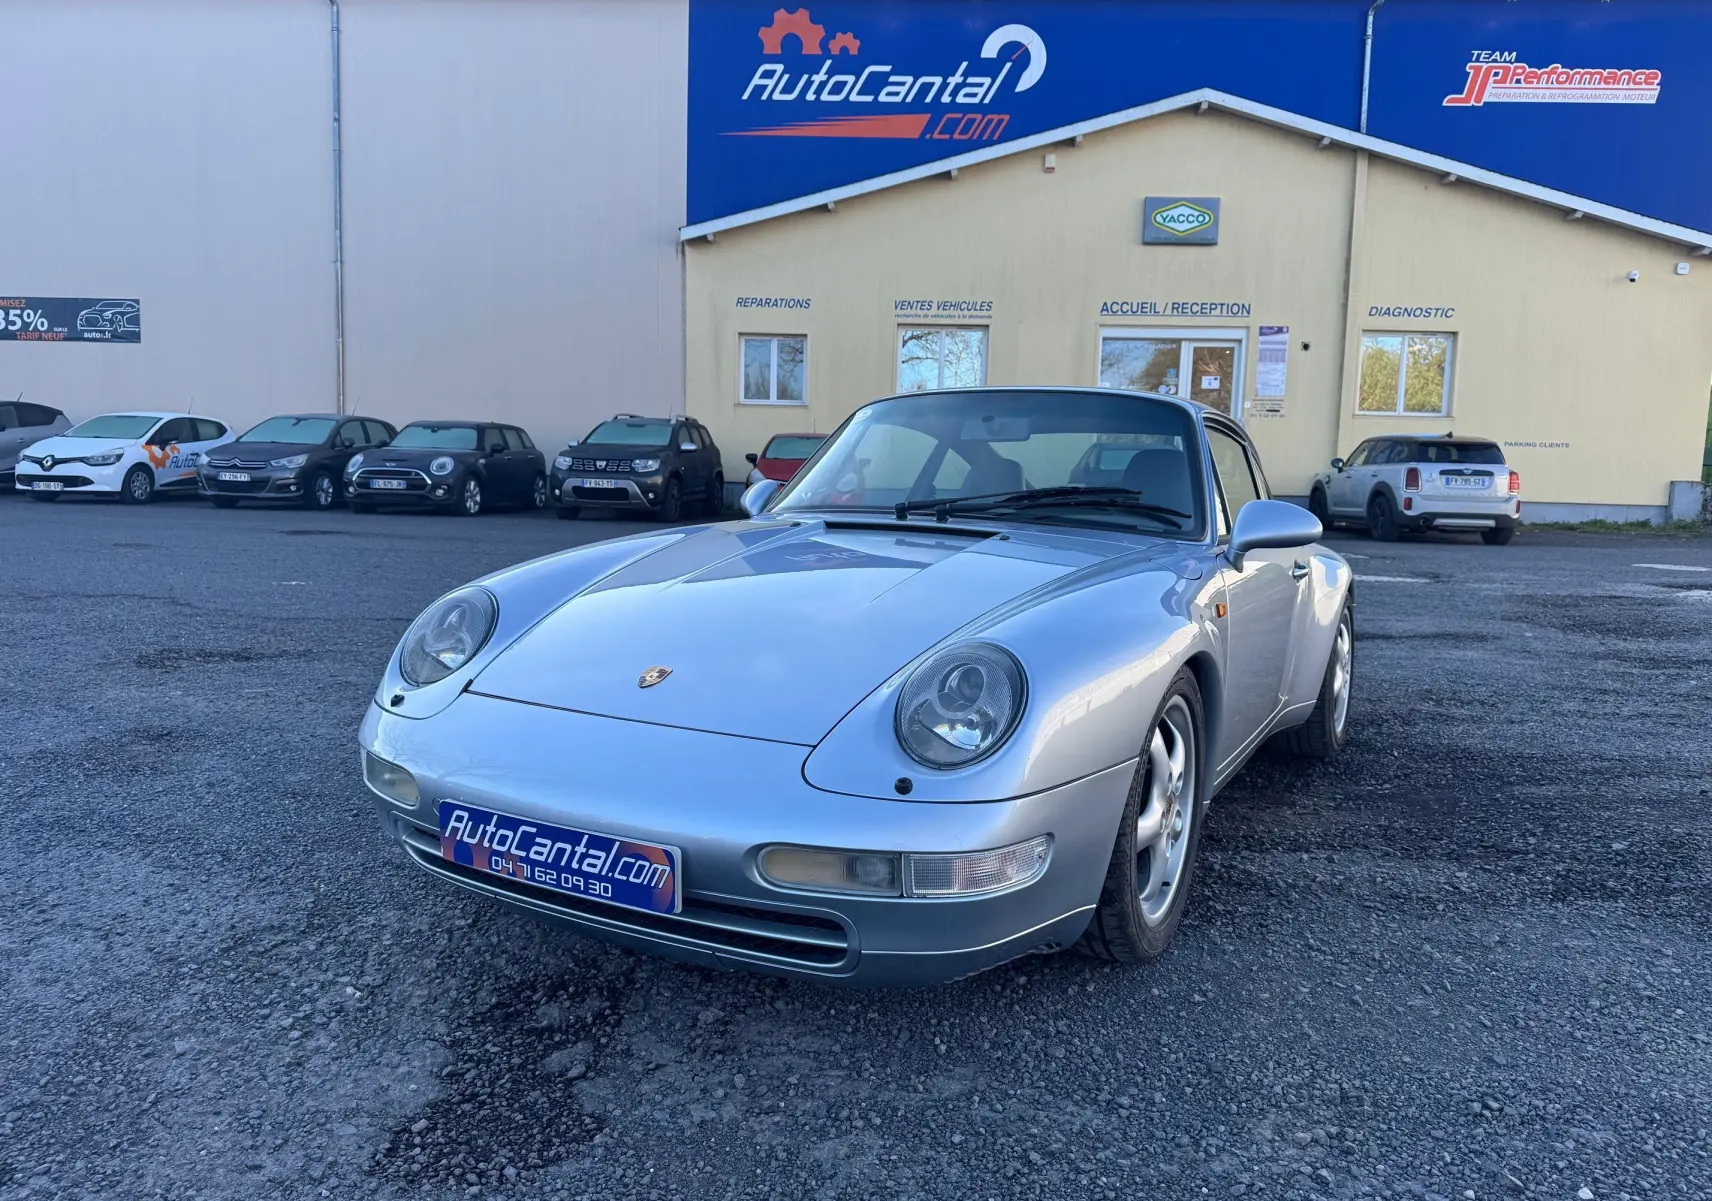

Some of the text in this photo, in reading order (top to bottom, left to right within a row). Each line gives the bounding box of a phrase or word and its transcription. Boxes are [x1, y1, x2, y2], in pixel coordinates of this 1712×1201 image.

[1471, 51, 1517, 62] TEAM
[741, 59, 1012, 104] AutoCantal
[1488, 92, 1656, 101] PREPARATION & REPROGRAMATION MOTEUR
[925, 113, 1010, 140] .com
[1160, 213, 1206, 224] YACCO
[735, 297, 812, 309] REPARATIONS
[894, 300, 993, 312] VENTES VEHICULES
[1100, 301, 1251, 316] ACCUEIL / RECEPTION
[1368, 306, 1455, 319] DIAGNOSTIC
[16, 332, 40, 340] TARIF
[445, 809, 671, 889] AutoCantal.com
[491, 856, 612, 897] 04 71 62 09 30
